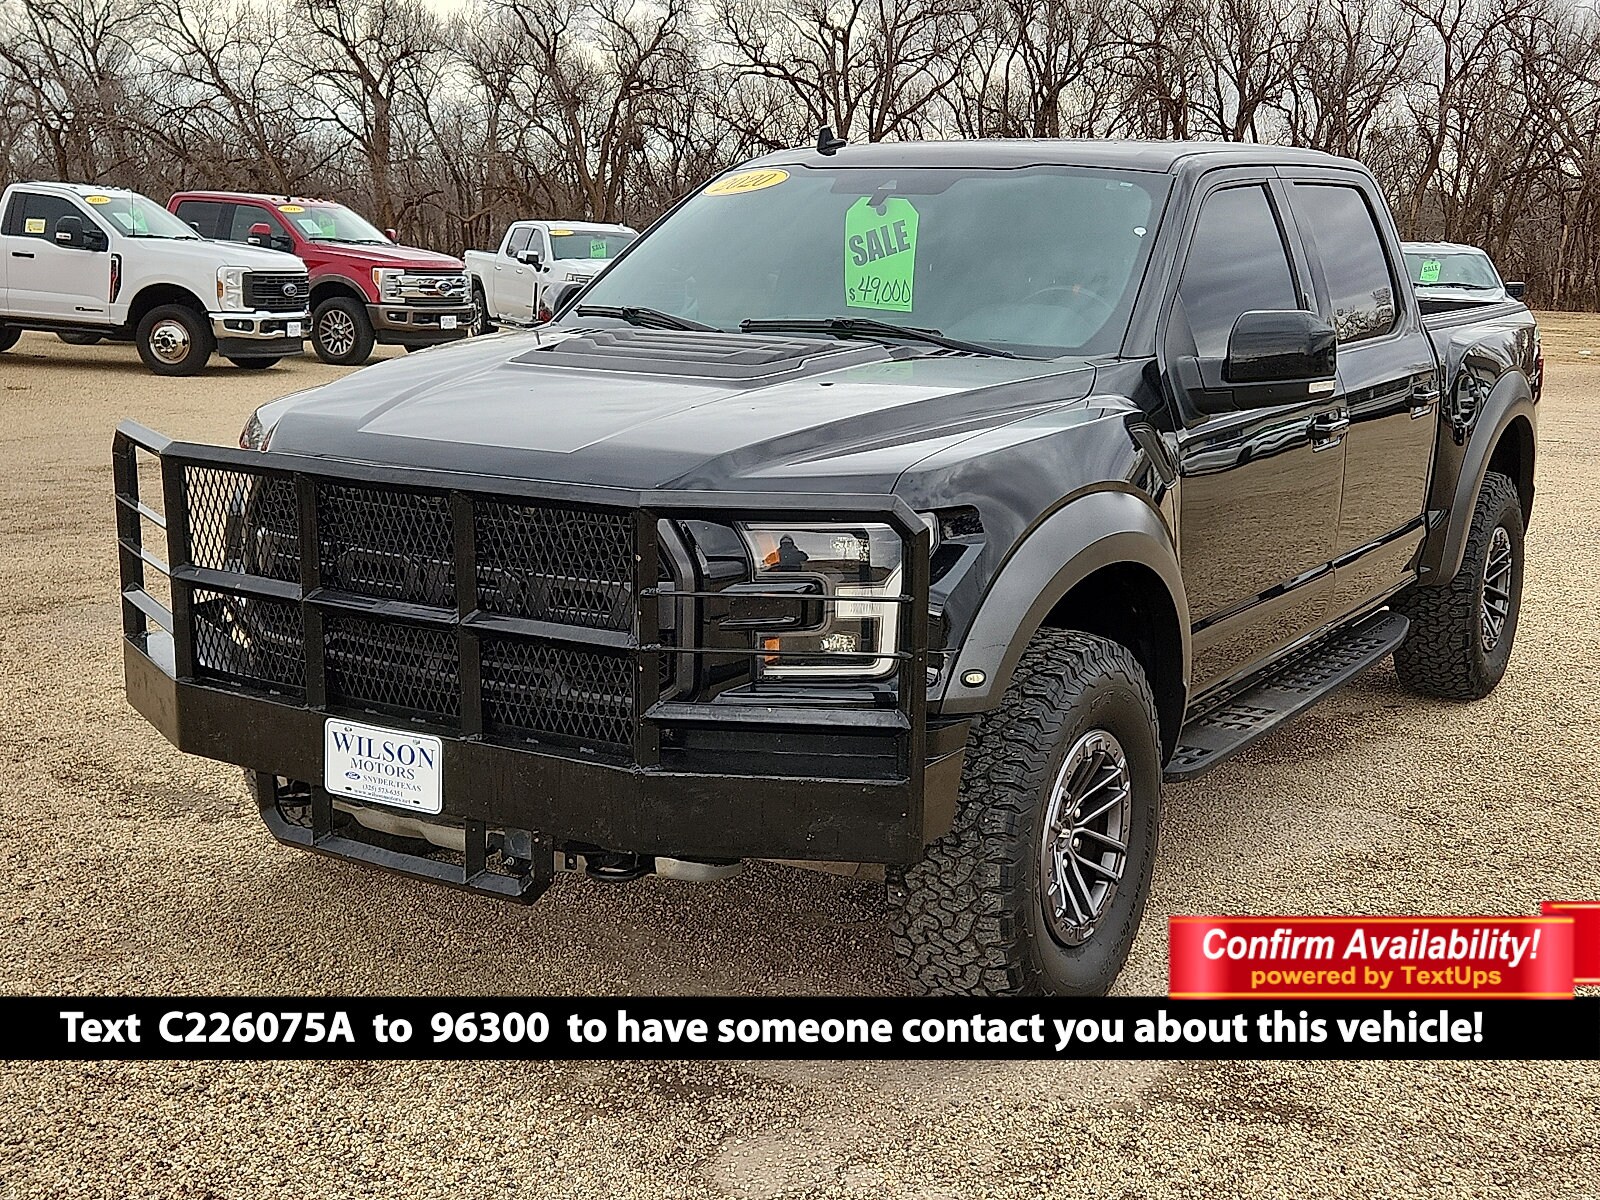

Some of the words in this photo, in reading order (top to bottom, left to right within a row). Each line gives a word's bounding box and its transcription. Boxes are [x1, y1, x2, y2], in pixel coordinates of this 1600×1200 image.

[711, 173, 777, 192] 2020
[848, 219, 911, 267] SALE
[1423, 264, 1438, 272] SALE
[332, 731, 436, 770] WILSON
[350, 757, 415, 780] MOTORS
[362, 784, 377, 792] (325)
[377, 786, 403, 797] 573-6351
